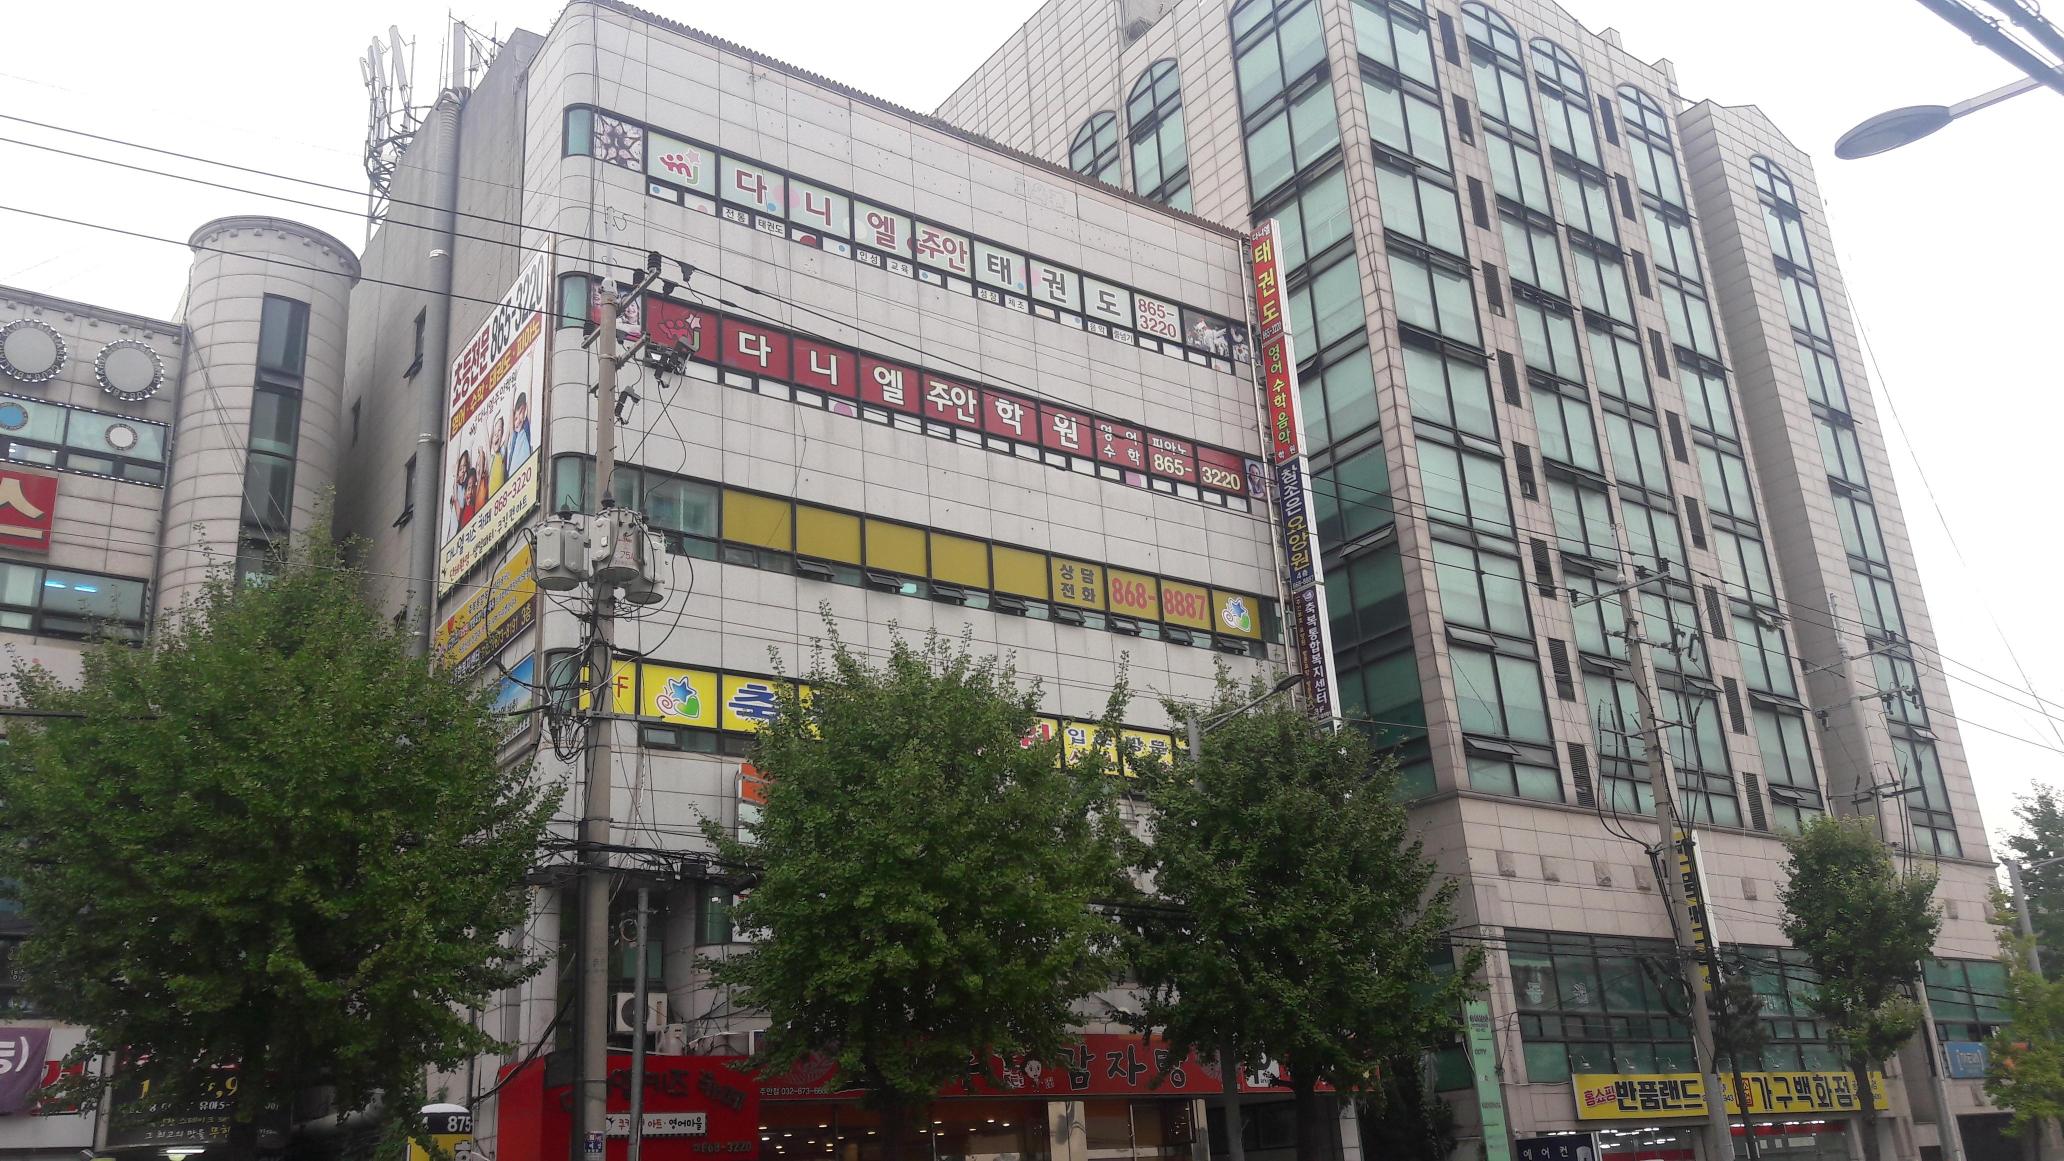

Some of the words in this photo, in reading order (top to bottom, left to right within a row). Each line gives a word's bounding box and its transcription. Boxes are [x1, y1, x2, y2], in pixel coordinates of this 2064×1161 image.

[757, 219, 784, 234] 태권도
[859, 251, 878, 266] 인성
[891, 261, 909, 274] 교육
[1254, 238, 1280, 326] 태권도
[490, 255, 545, 363] 865-3220
[1139, 314, 1177, 339] 3220
[1268, 343, 1283, 374] 영어
[1272, 377, 1287, 409] 수학
[1099, 423, 1138, 446] 영어
[1276, 411, 1292, 445] 음악
[1103, 443, 1141, 467] 수학
[1059, 564, 1095, 585] 상담
[1060, 582, 1096, 603] 전화
[1614, 1079, 1703, 1111] 반품랜드
[1751, 1074, 1853, 1110] 가구백화점
[668, 1116, 703, 1130] 영어마을
[1523, 1145, 1569, 1161] 에어컨
